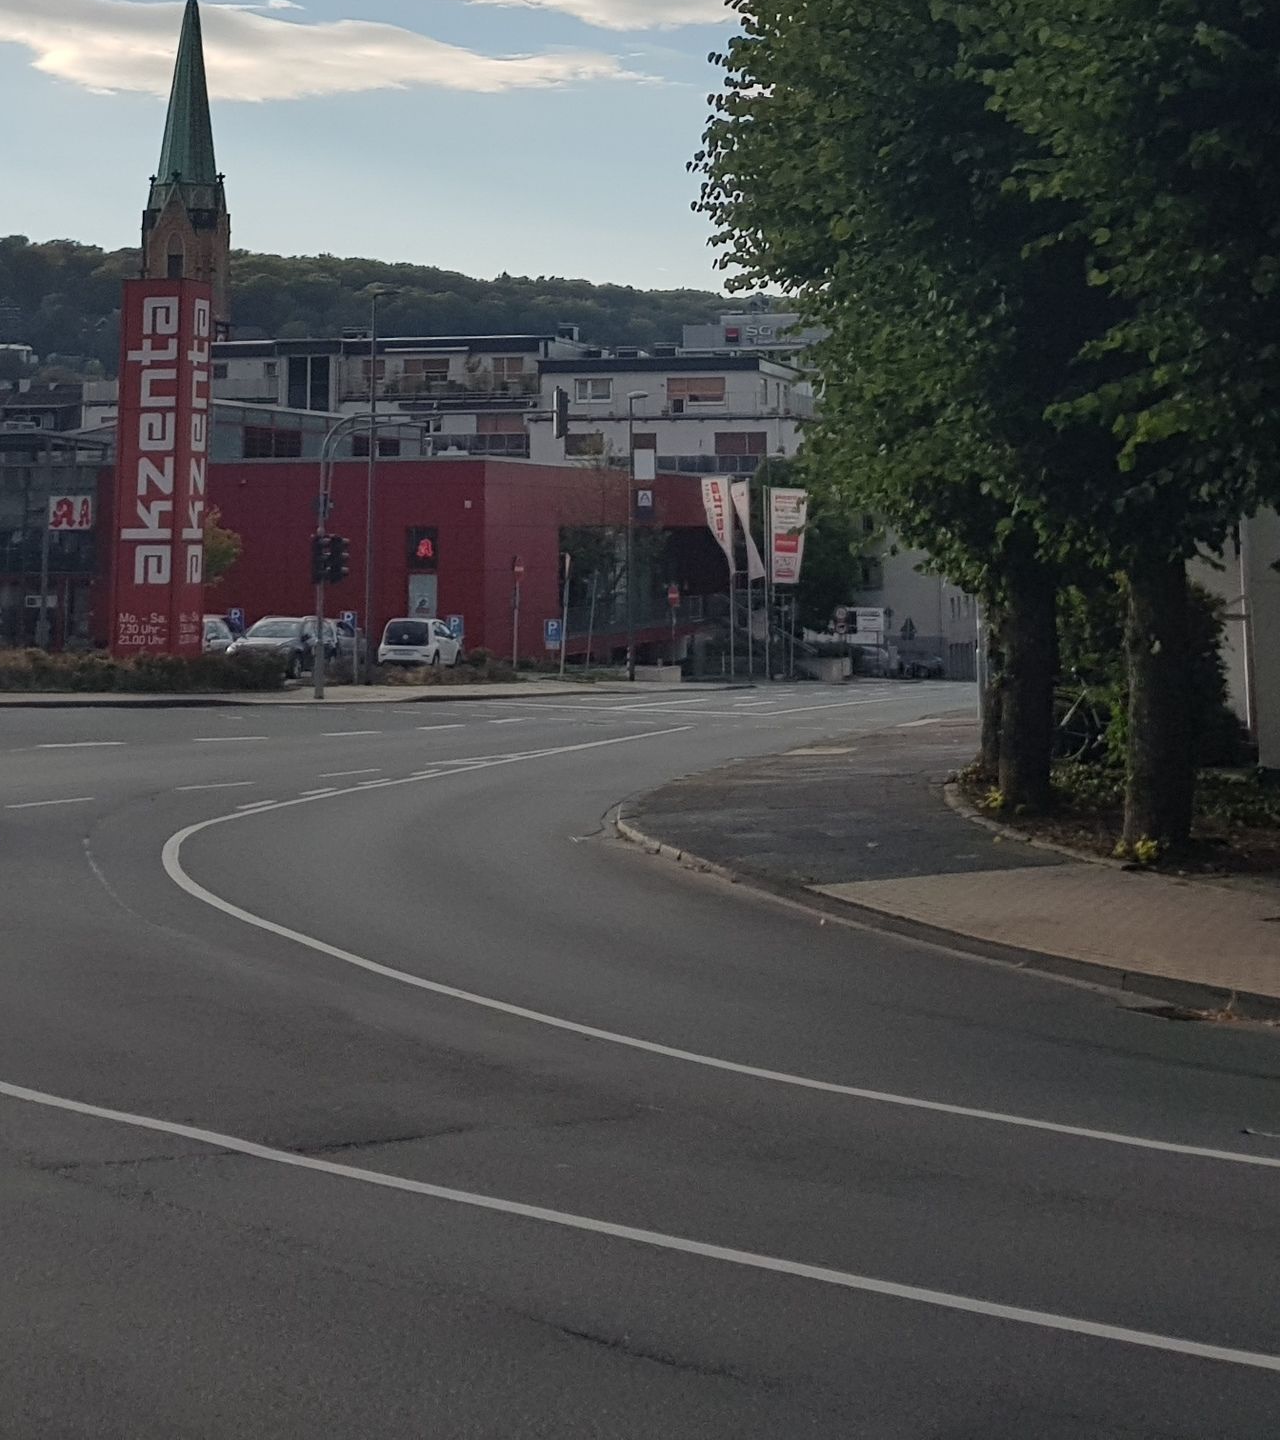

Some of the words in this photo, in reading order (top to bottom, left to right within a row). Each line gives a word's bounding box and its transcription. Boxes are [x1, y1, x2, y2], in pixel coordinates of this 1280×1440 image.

[121, 296, 179, 585] akzenta
[182, 298, 210, 585] akzenta
[548, 621, 558, 635] P
